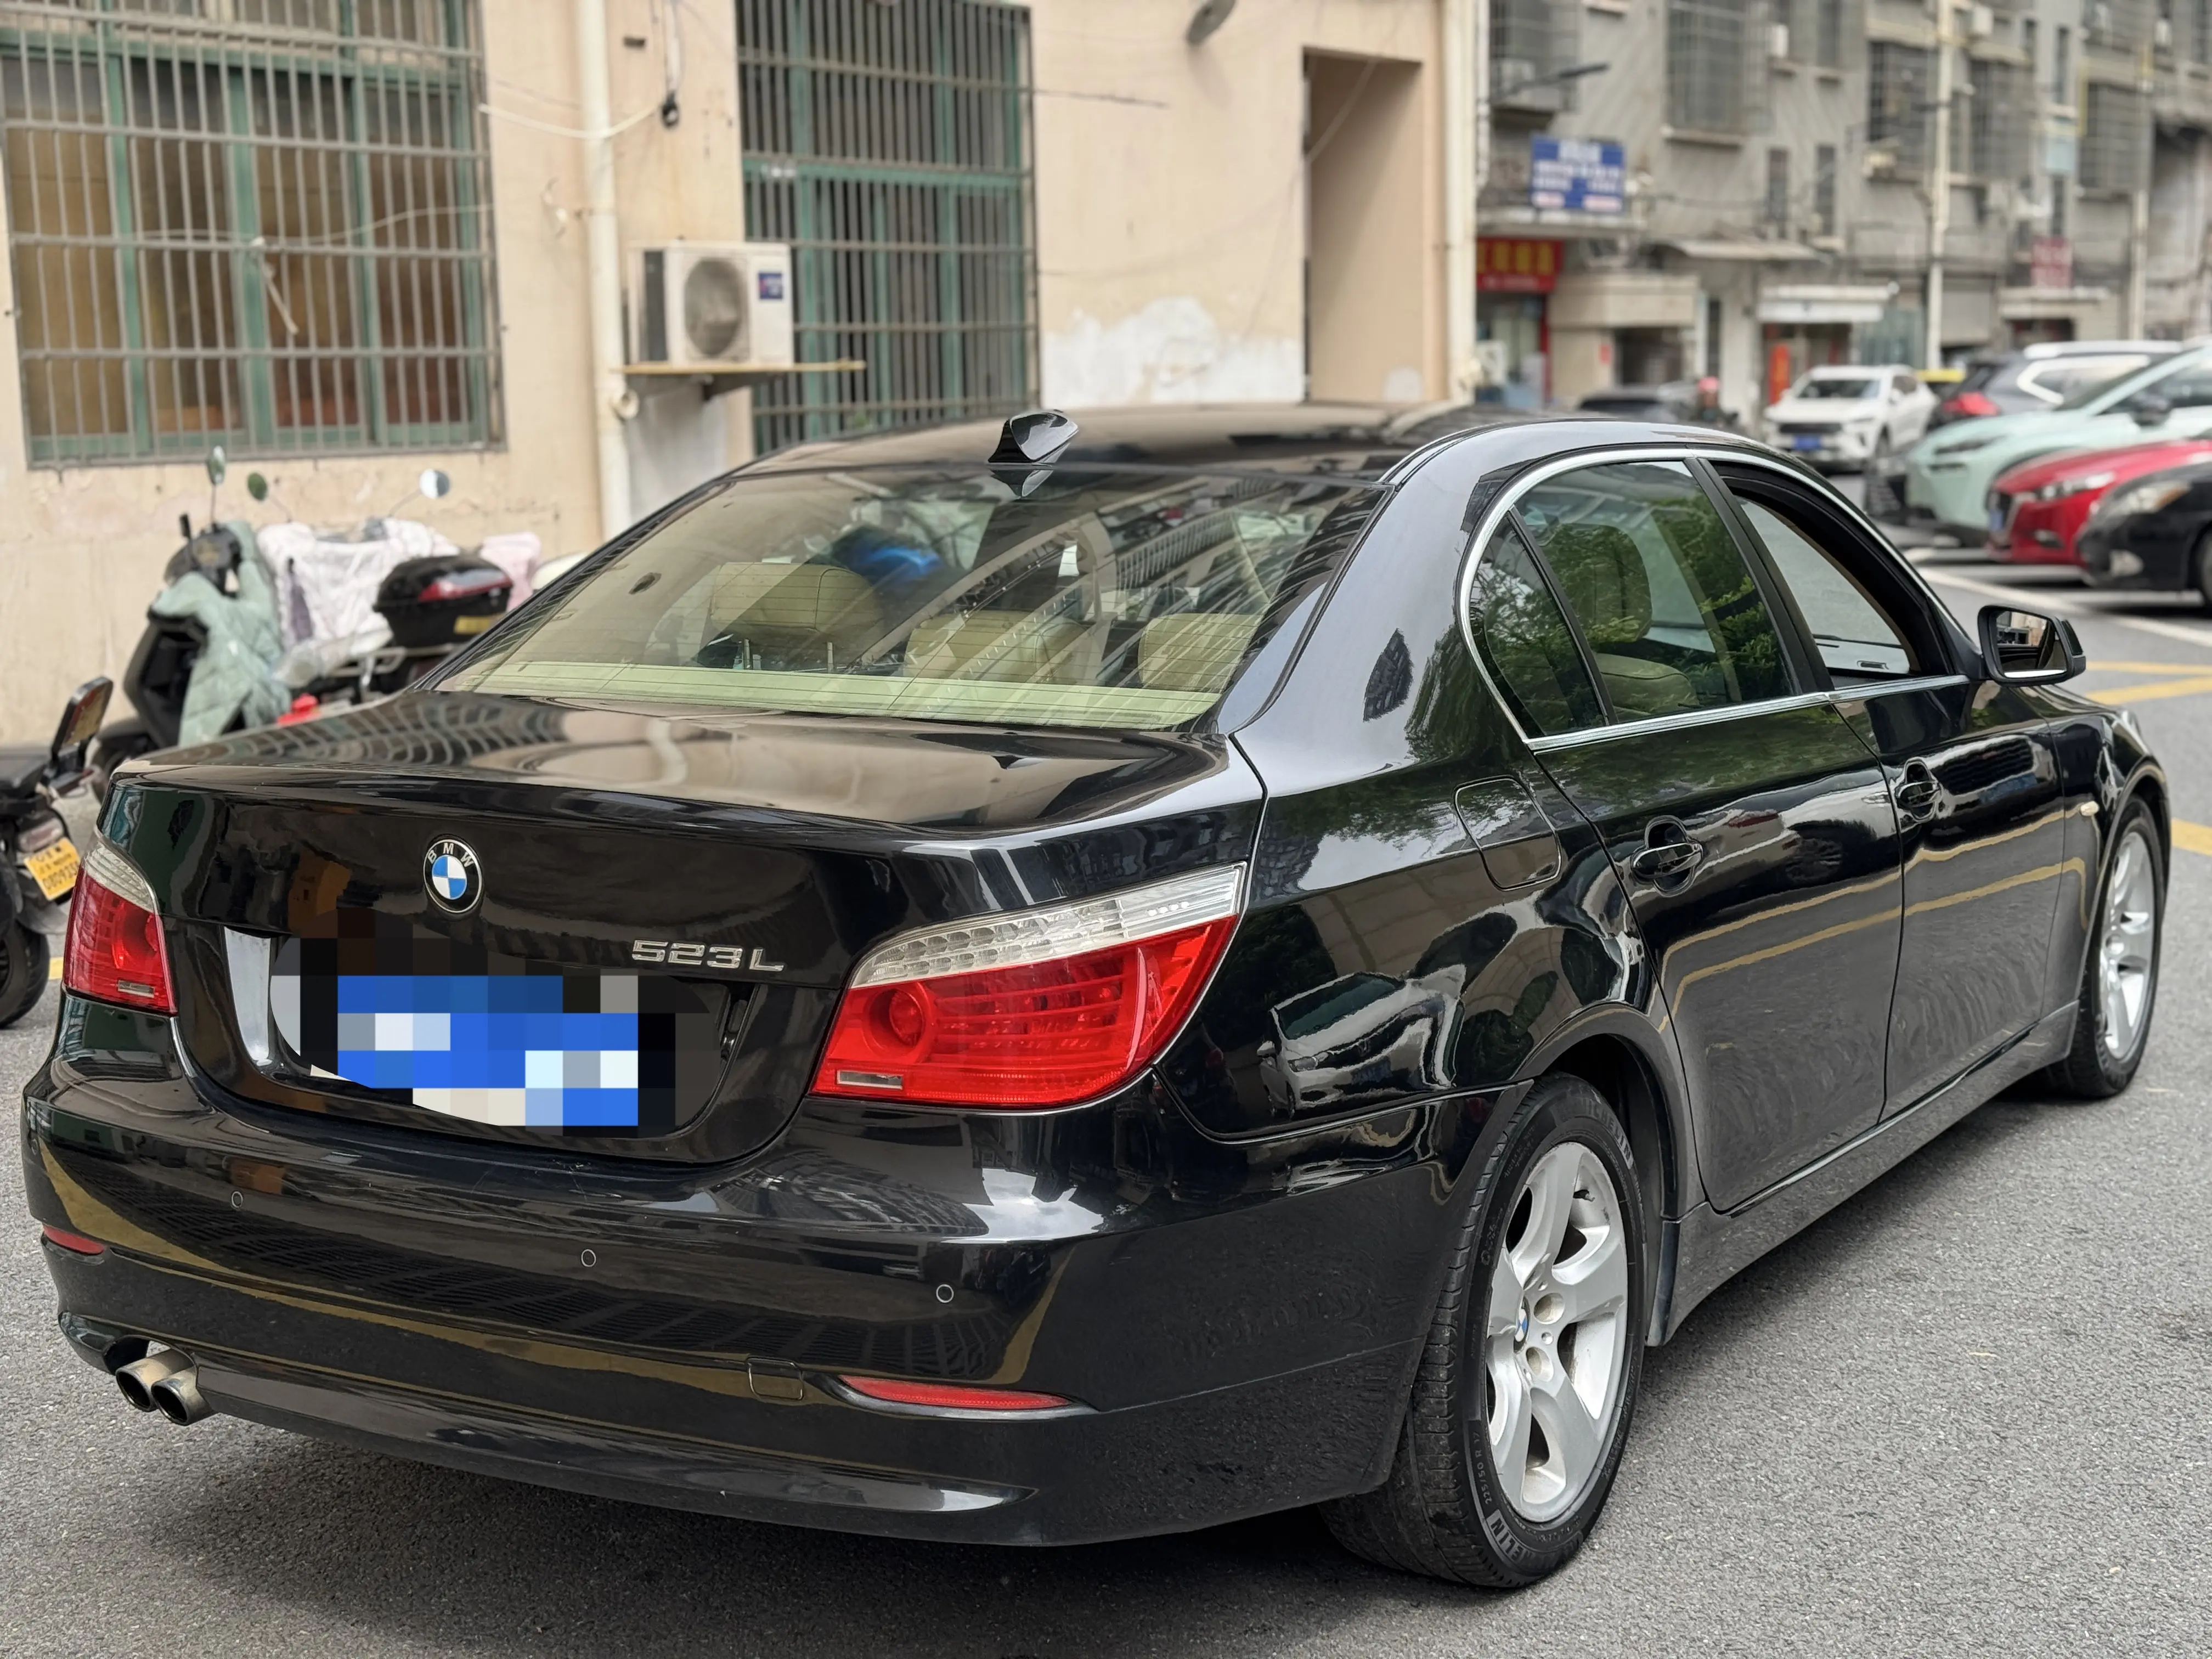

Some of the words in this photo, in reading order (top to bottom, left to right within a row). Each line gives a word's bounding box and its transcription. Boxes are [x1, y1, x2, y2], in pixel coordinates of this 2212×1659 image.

[427, 842, 474, 868] BMW
[631, 940, 785, 972] 523L
[1472, 1431, 1480, 1444] 17
[1475, 1449, 1482, 1458] R
[1476, 1462, 1492, 1505] 225/50
